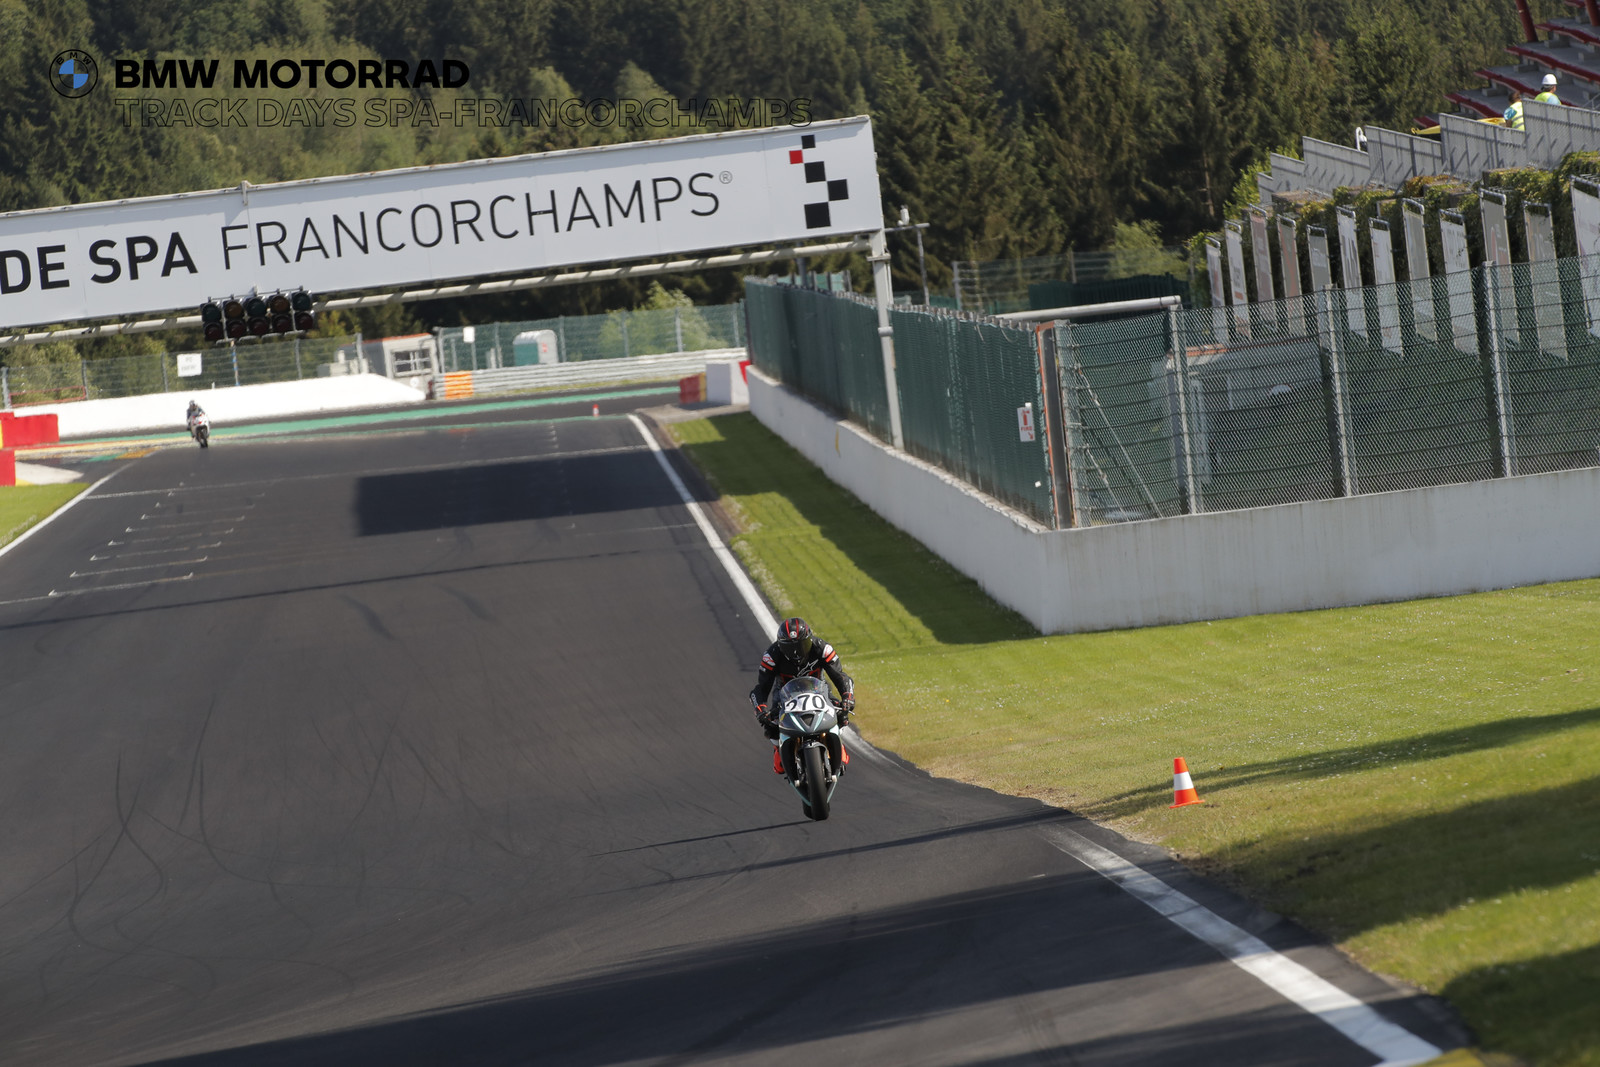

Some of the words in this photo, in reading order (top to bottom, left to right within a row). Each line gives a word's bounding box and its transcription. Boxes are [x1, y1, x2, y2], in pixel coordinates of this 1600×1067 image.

[0, 244, 70, 295] DE
[89, 231, 199, 284] SPA
[785, 694, 826, 711] 270
